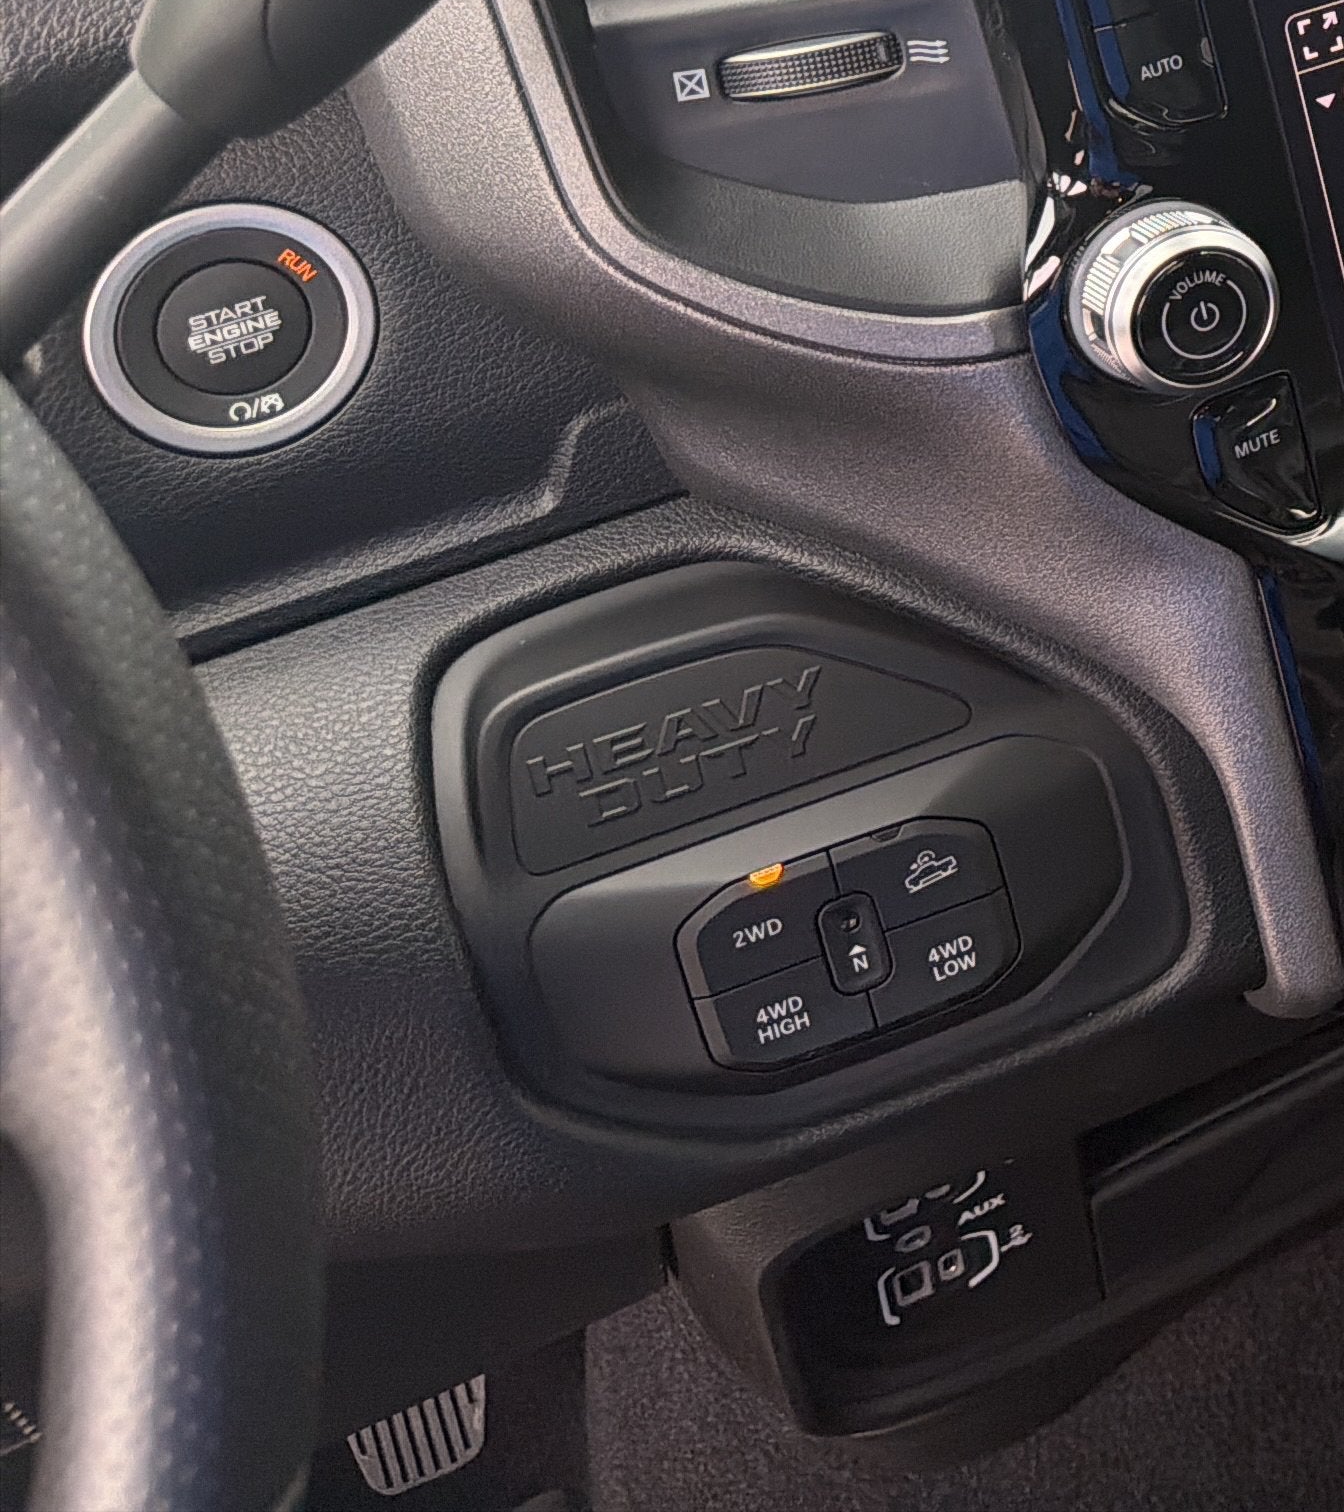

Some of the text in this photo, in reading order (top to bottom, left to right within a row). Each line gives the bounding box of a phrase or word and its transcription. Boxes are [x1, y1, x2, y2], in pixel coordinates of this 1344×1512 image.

[1140, 55, 1184, 81] AUTO
[277, 248, 318, 283] RUN
[1169, 269, 1227, 303] VOLUME
[188, 295, 267, 332] START
[187, 310, 282, 352] ENGINE
[207, 333, 274, 365] STOP
[1235, 428, 1281, 459] MUTE
[525, 665, 822, 798] HEAVY
[578, 714, 817, 828] DUTY
[733, 918, 783, 948] 2WD
[928, 935, 973, 963] 4WD
[853, 954, 869, 973] N
[933, 952, 977, 982] LOW
[756, 995, 803, 1023] 4WD
[757, 1012, 810, 1044] HIGH
